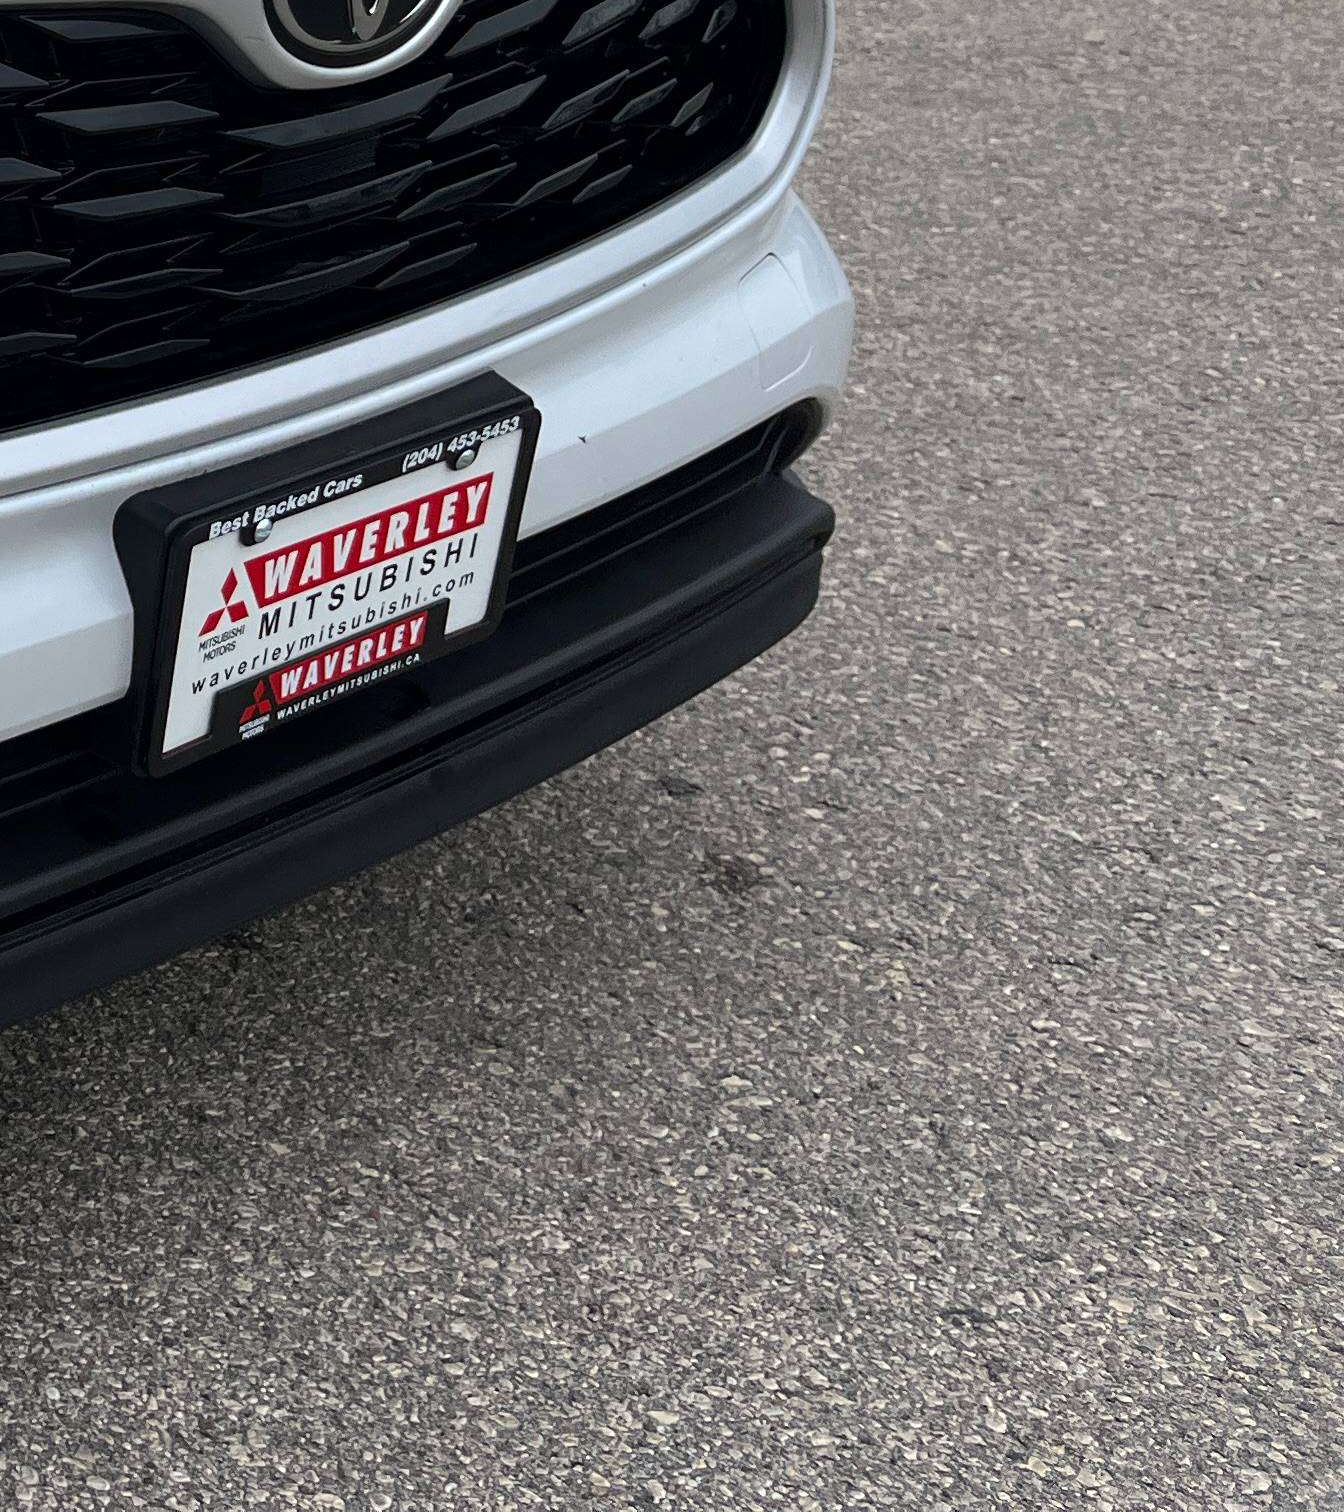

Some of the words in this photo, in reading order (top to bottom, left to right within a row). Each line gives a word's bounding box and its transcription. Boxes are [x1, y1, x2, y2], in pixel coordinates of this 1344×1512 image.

[402, 442, 443, 473] (204)
[446, 415, 520, 452] 453-5453
[209, 511, 251, 539] Best
[252, 486, 320, 523] Backed
[323, 474, 363, 498] Cars
[264, 481, 487, 599] WAVERLEY
[258, 533, 478, 640] MITSUBISHI
[192, 570, 475, 694] waverleymitsubishi.com
[198, 624, 246, 653] MITSUBISHI
[202, 640, 237, 663] MOTORS
[281, 616, 426, 700] WAVERLEY
[277, 652, 421, 720] WAVERLEYMITSUBISHI.CA
